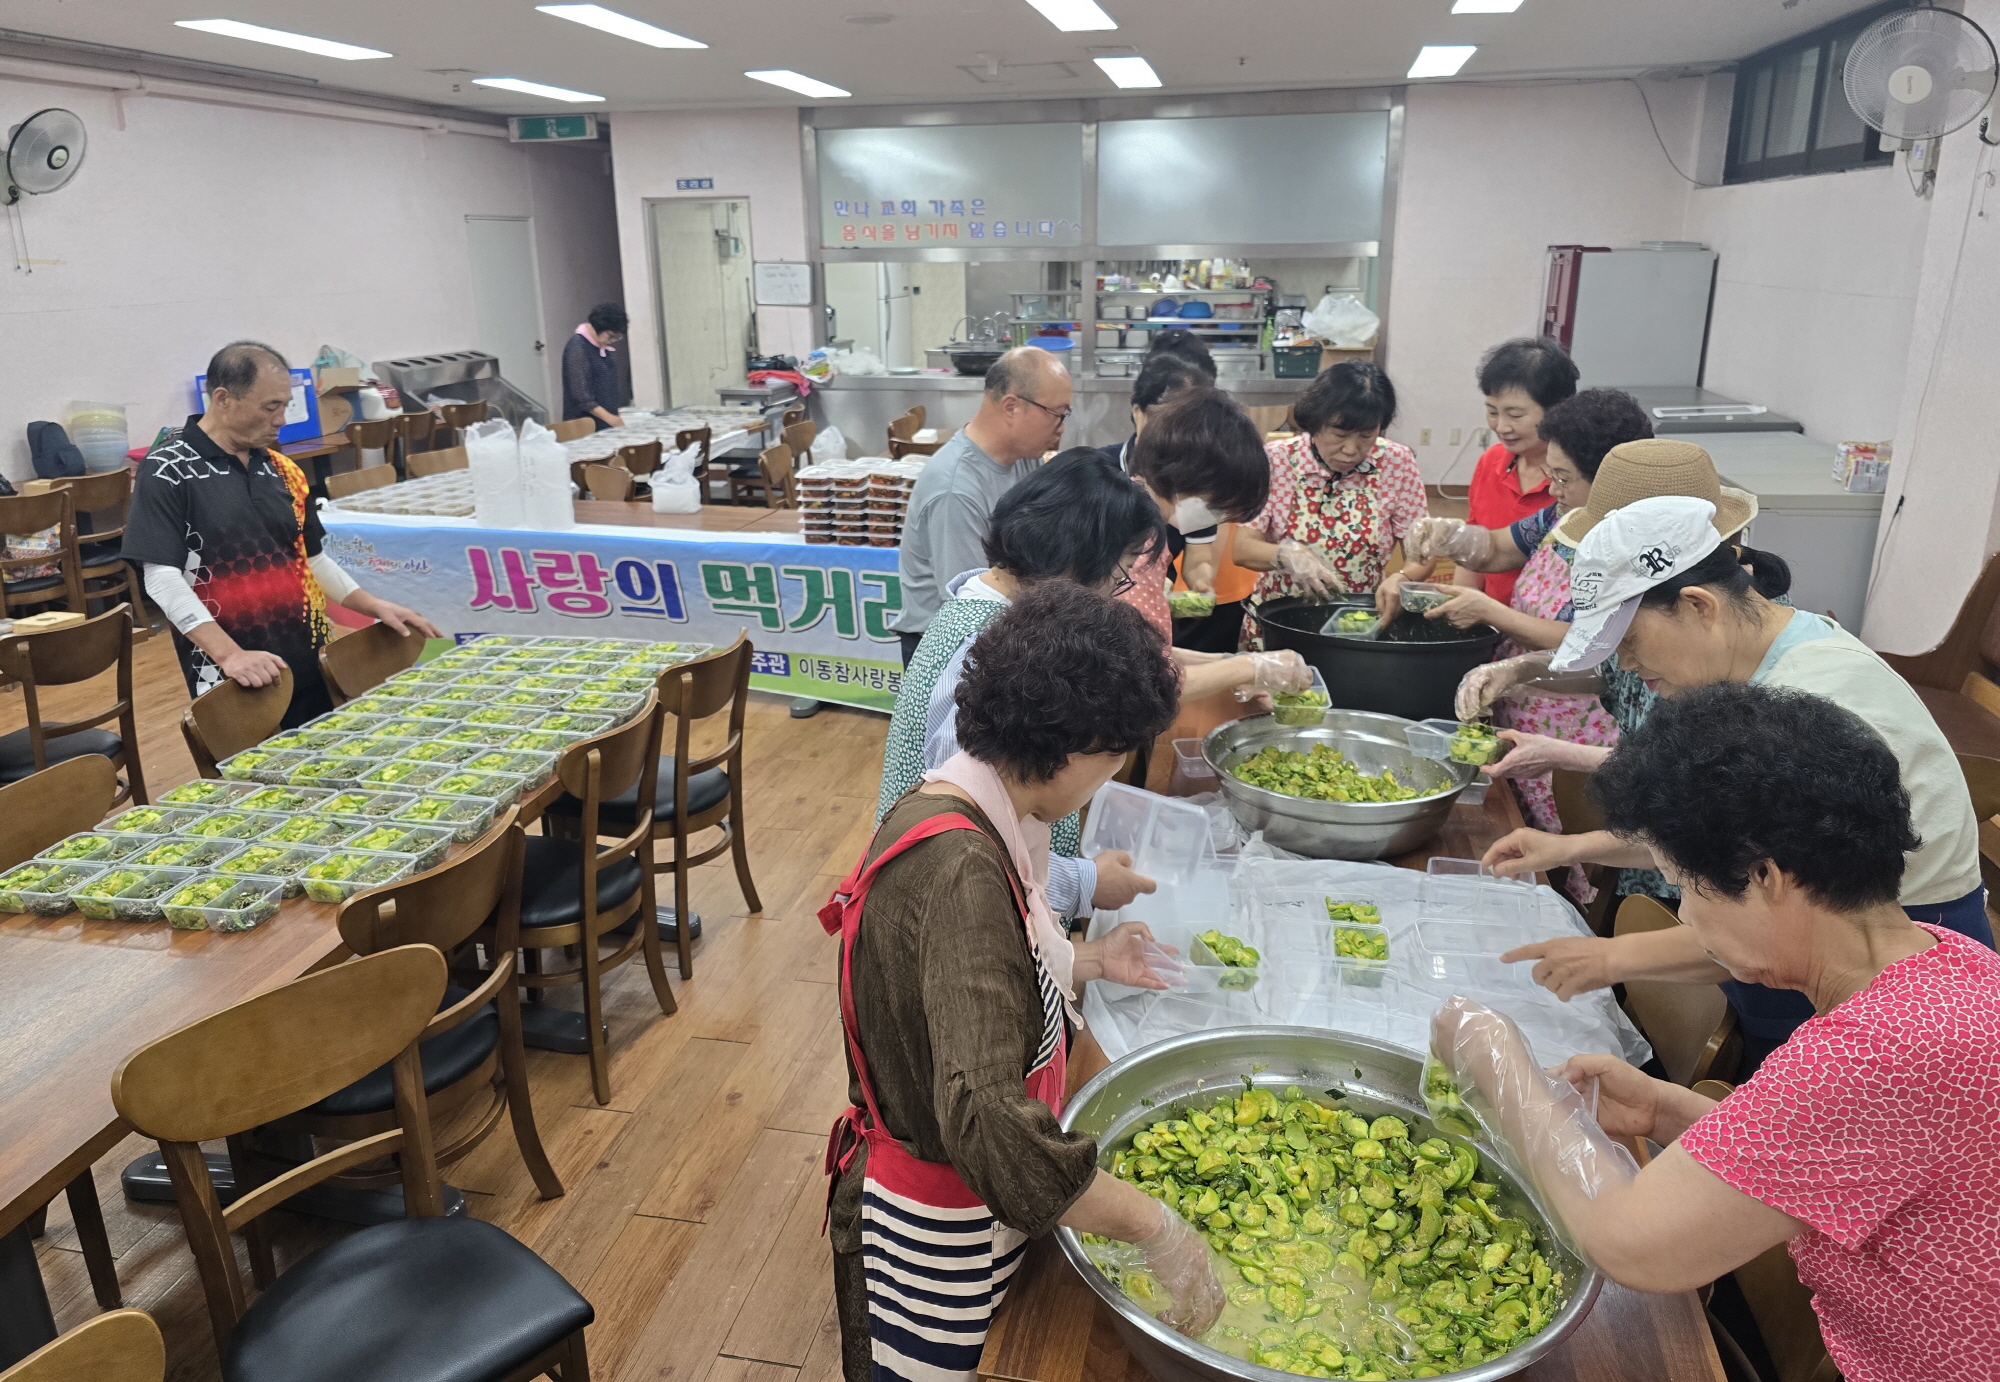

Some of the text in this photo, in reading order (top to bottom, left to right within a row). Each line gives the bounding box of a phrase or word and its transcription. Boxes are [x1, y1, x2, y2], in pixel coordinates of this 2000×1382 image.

[833, 199, 986, 217] 만나 교회 가족은
[842, 224, 896, 241] 음식을
[905, 223, 958, 240] 남기지
[1639, 547, 1673, 577] R
[466, 545, 689, 622] 사랑의
[751, 652, 786, 675] 주관
